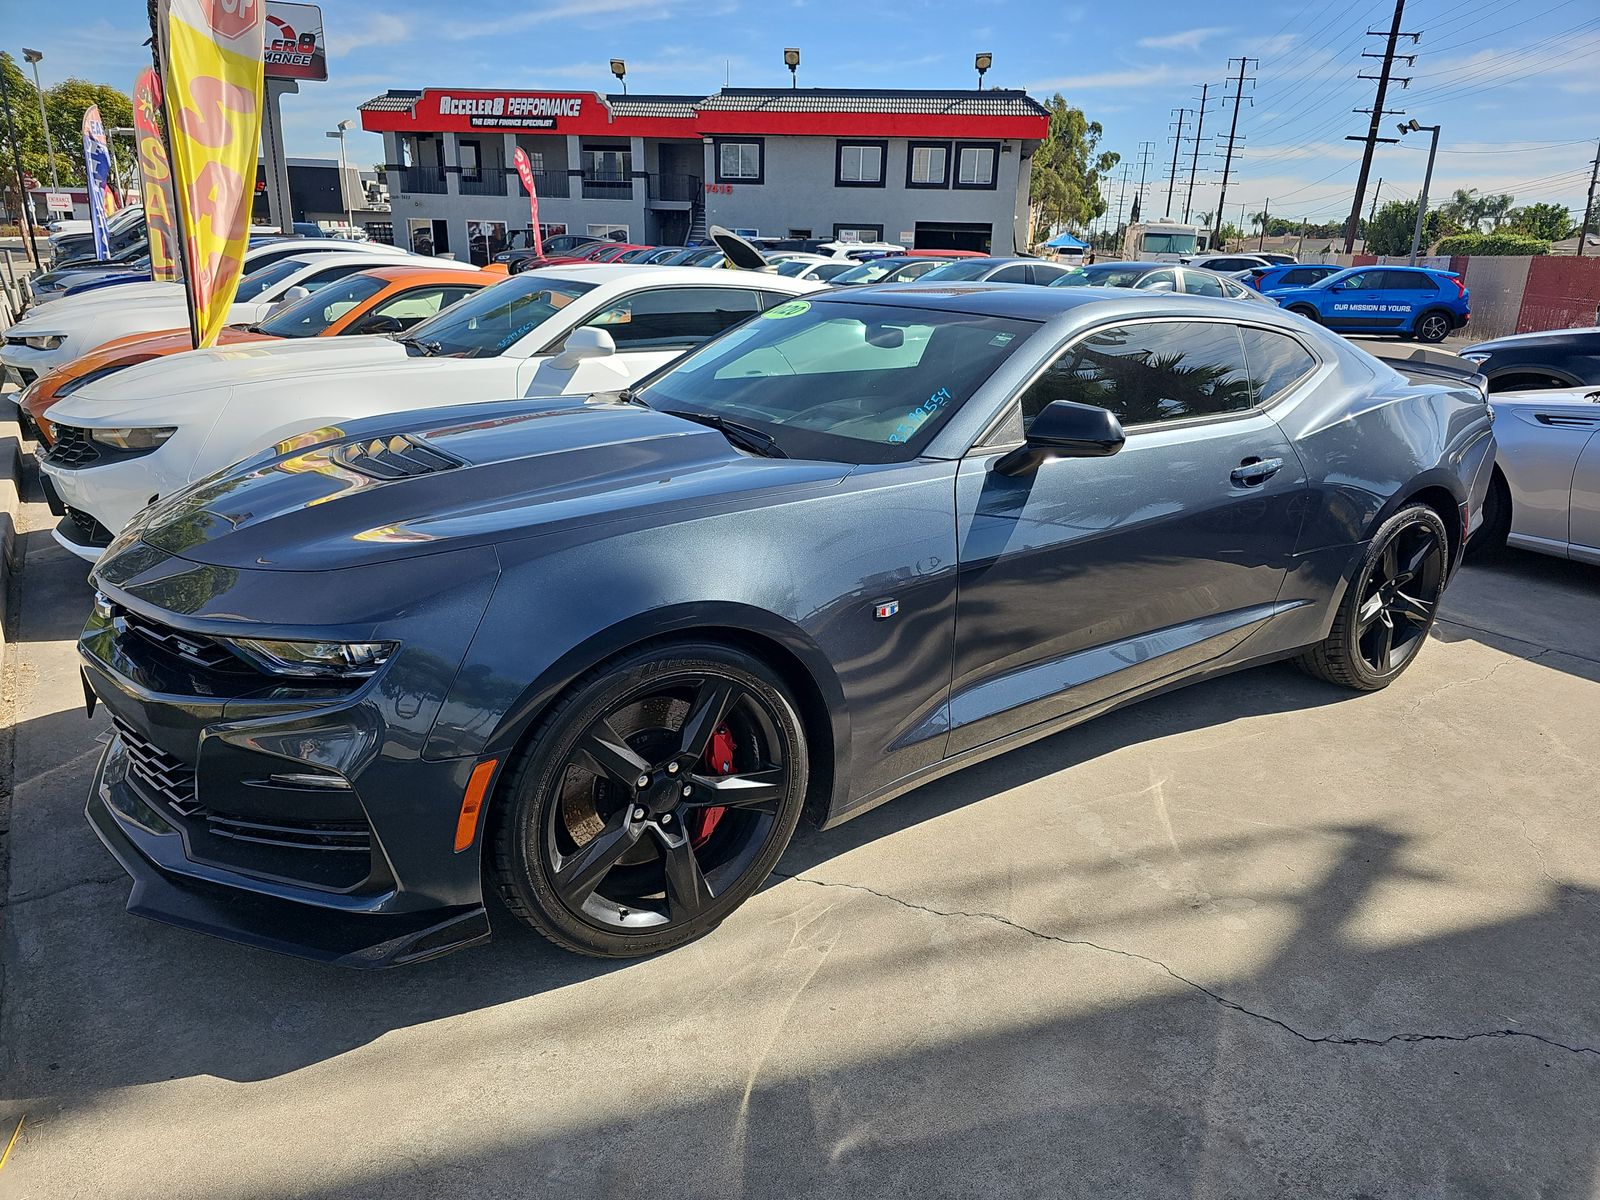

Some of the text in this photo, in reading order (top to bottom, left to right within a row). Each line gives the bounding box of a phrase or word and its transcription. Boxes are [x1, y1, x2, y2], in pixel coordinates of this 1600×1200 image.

[439, 96, 582, 117] ACCELER8 PERFORMANCE
[472, 118, 553, 127] THE EASY FINANCE SPECIALIST
[1333, 303, 1349, 311] OUR
[1349, 304, 1379, 312] MISSION
[1387, 305, 1412, 313] YOURS.
